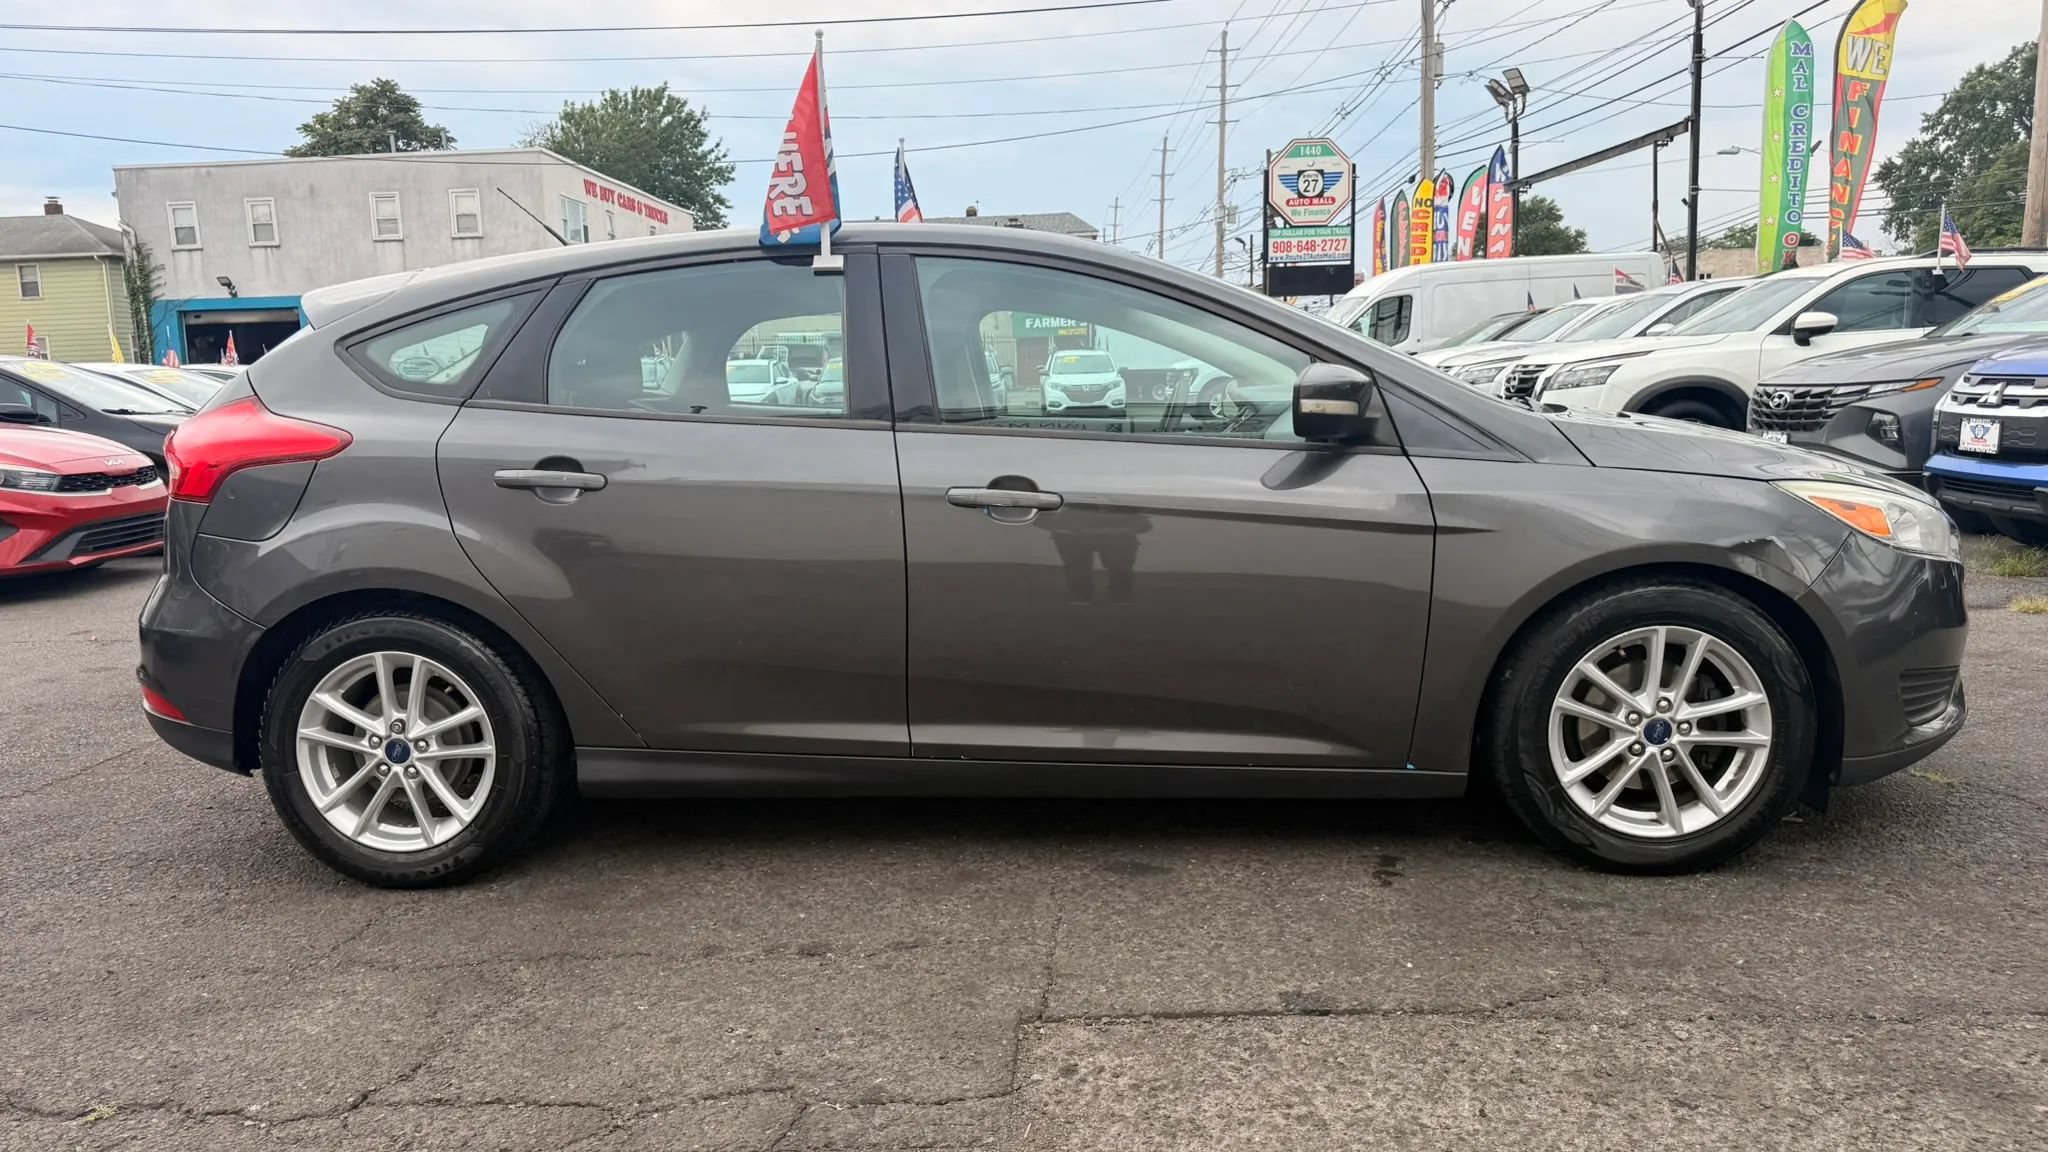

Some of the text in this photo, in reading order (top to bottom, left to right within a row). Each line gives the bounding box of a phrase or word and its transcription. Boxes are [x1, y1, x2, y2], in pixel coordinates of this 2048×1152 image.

[1847, 35, 1890, 75] WE
[1791, 41, 1813, 91] MAL
[1300, 146, 1322, 156] 1440
[1785, 104, 1809, 224] CREDITO
[1302, 179, 1319, 193] 27
[584, 178, 598, 198] WE
[599, 185, 616, 204] BUY
[617, 192, 636, 212] CARS
[643, 203, 668, 225] TRUCKS
[1415, 199, 1433, 208] NO
[1303, 208, 1331, 216] Finance
[1272, 239, 1348, 253] 908-648-2727
